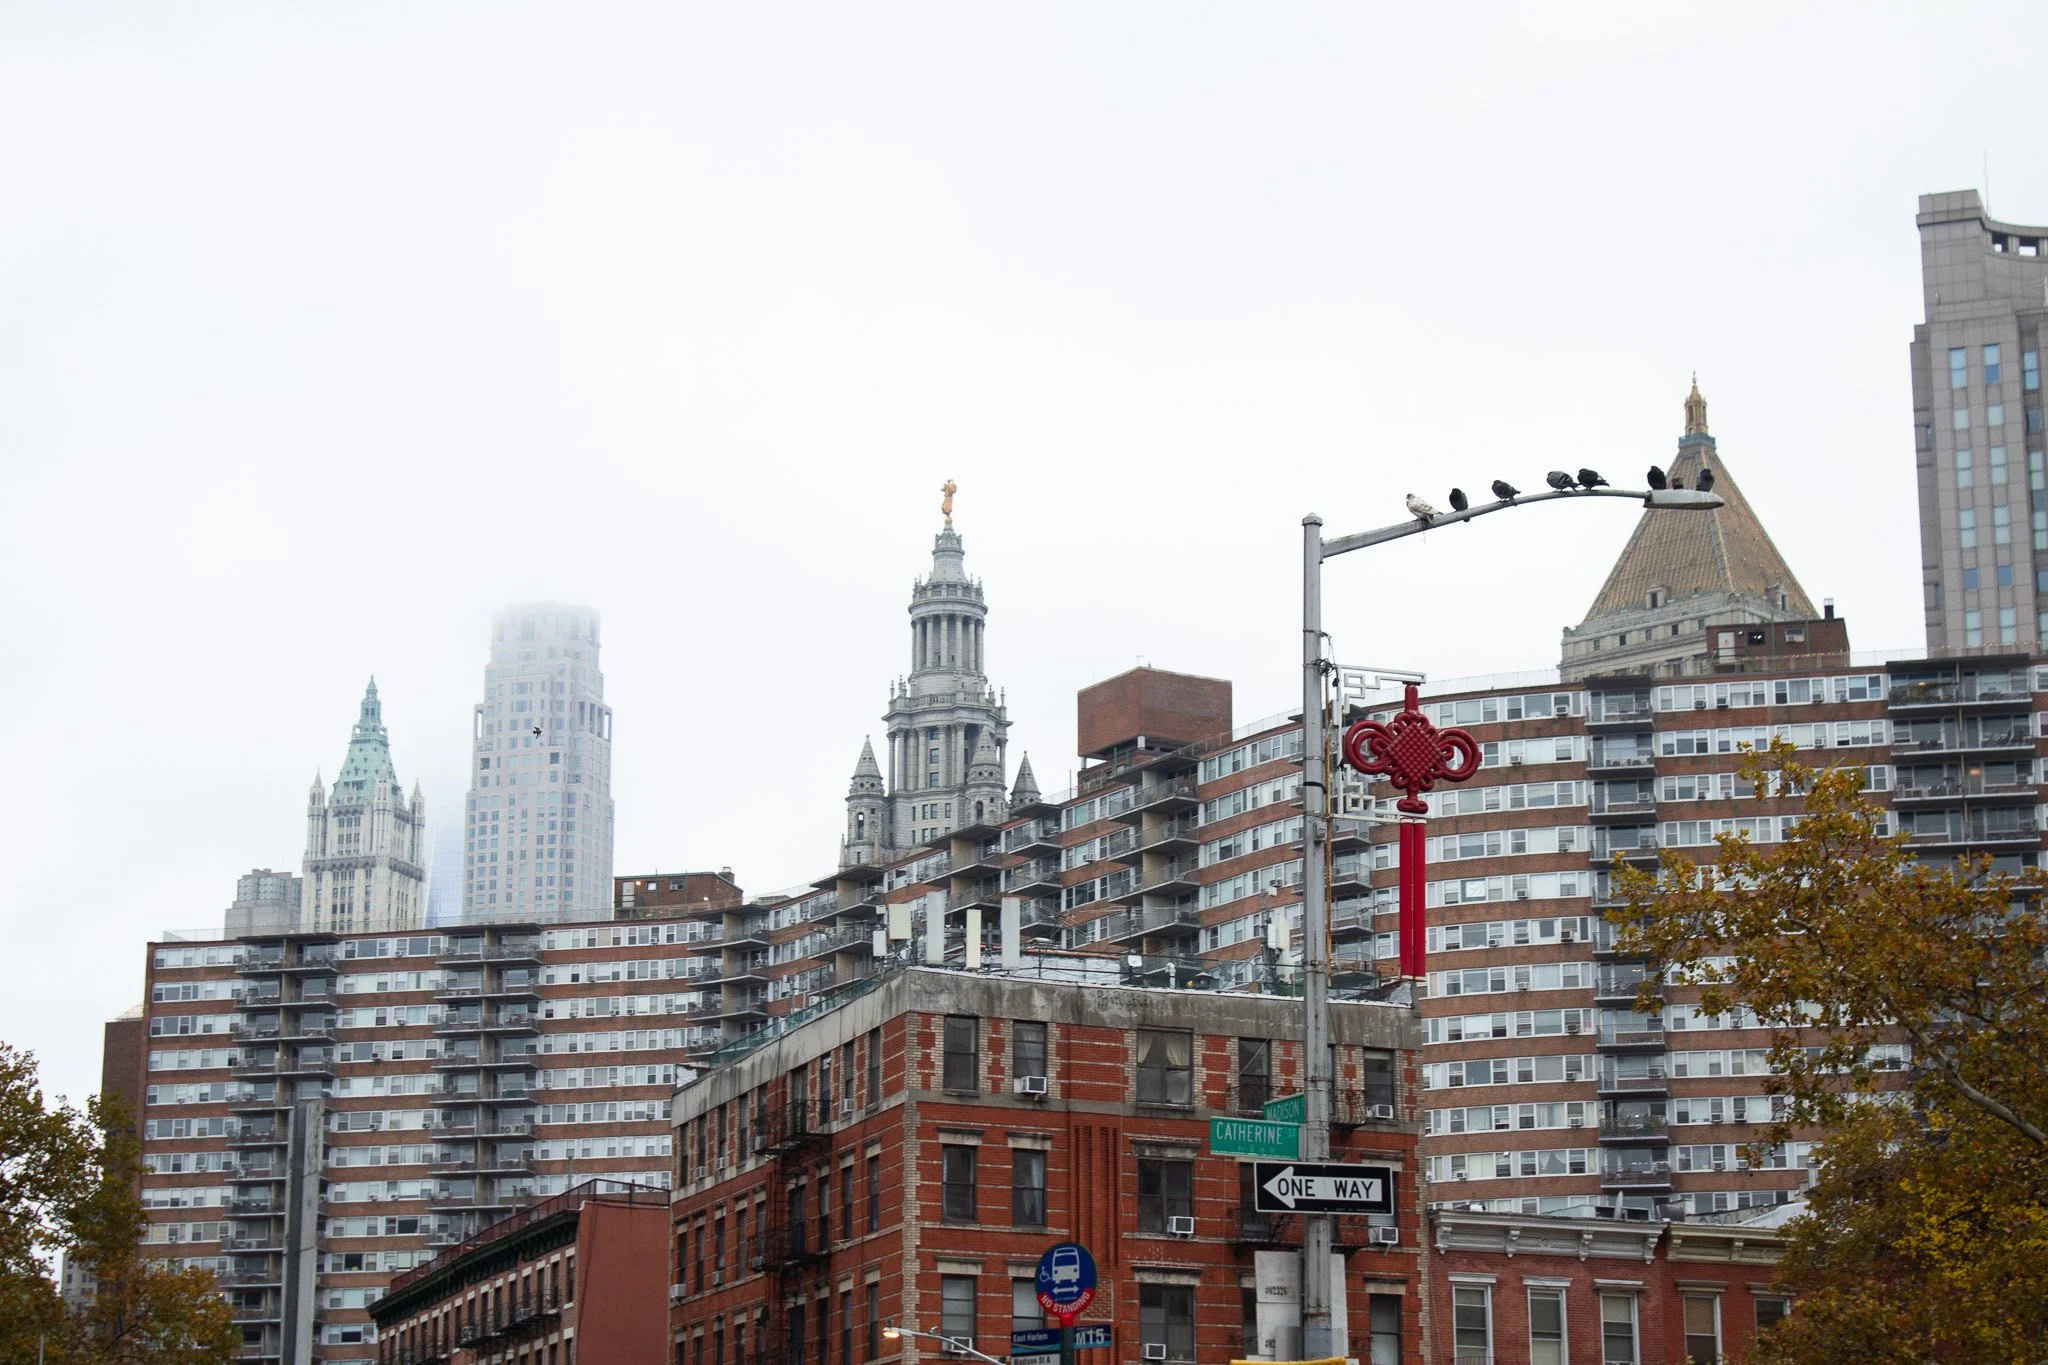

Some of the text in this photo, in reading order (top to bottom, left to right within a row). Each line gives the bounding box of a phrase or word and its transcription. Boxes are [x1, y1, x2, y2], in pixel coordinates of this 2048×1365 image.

[1266, 1101, 1300, 1121] MADISON
[1216, 1121, 1297, 1145] CATHERINE ST
[1277, 1177, 1374, 1199] ONE WAY
[1040, 1291, 1091, 1313] NO STANDING
[1012, 1332, 1049, 1343] East Harlem
[1075, 1328, 1105, 1346] M15
